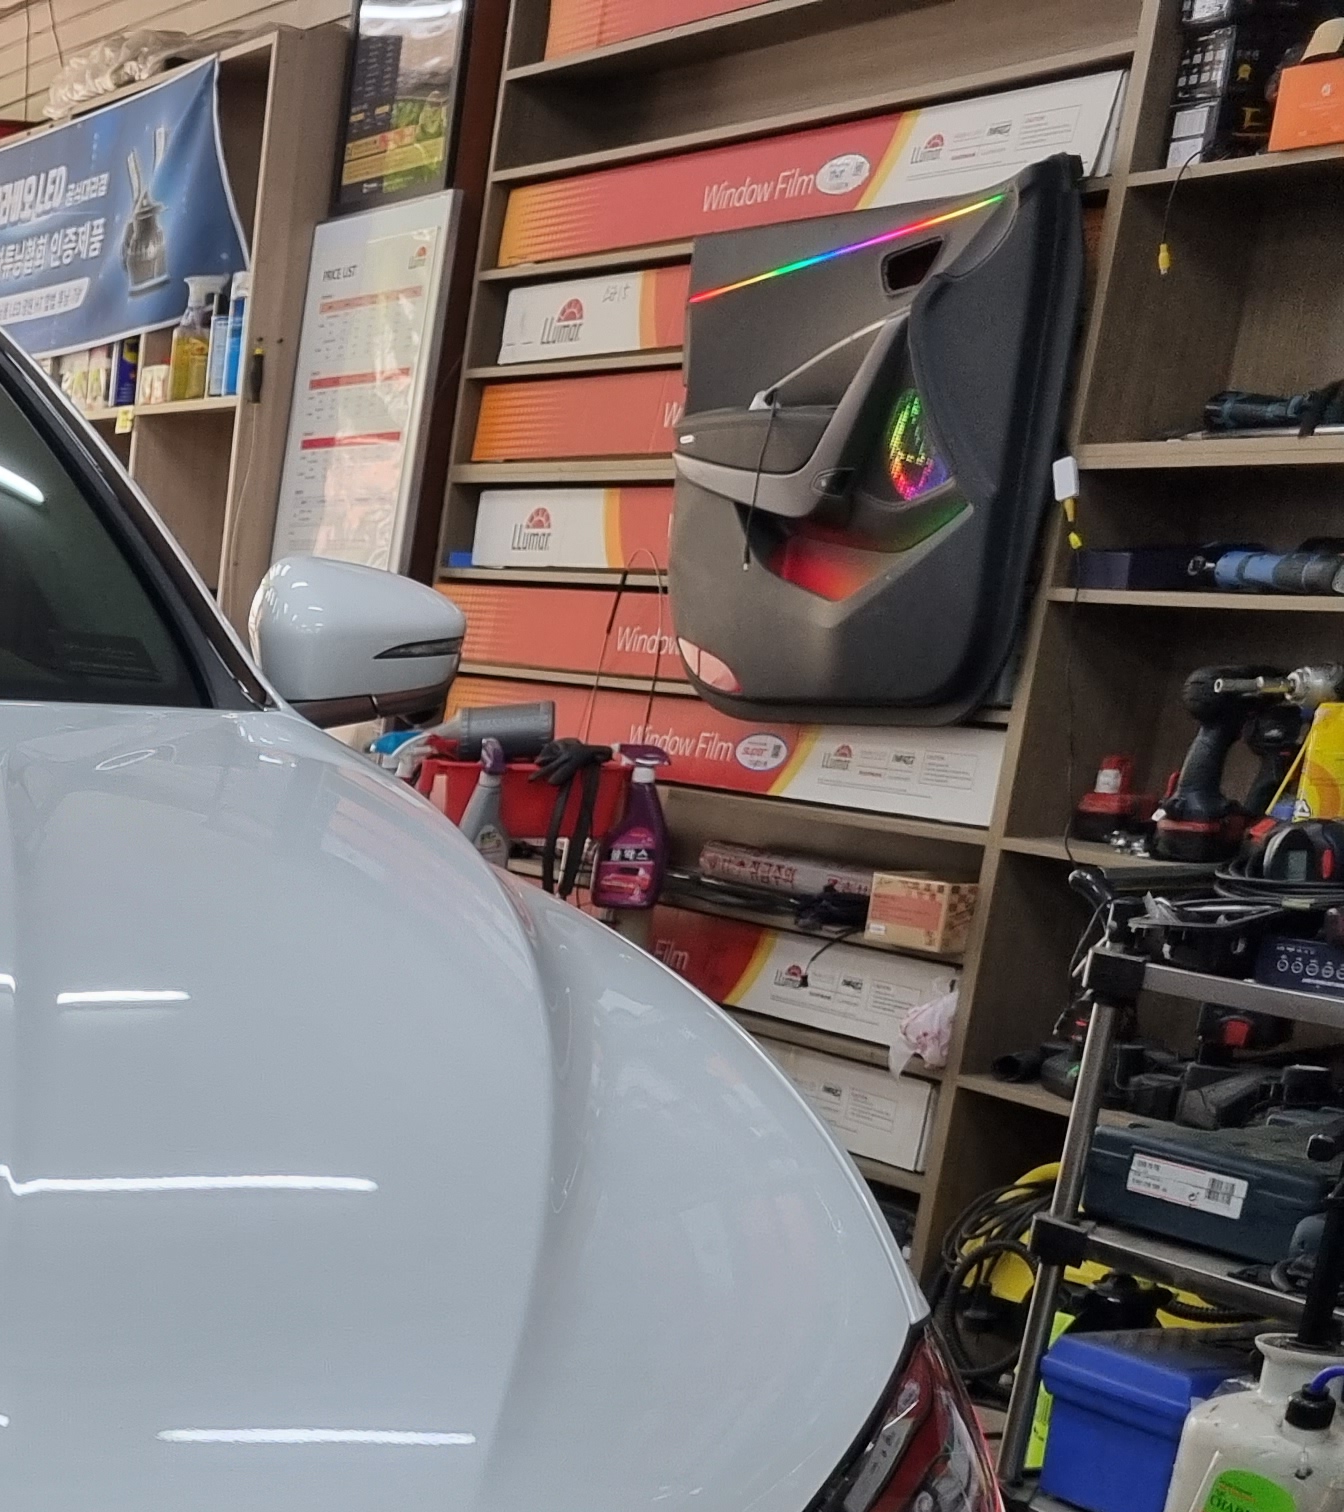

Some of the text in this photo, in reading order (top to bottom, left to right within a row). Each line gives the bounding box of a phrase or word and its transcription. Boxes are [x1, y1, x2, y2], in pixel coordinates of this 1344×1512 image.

[702, 175, 775, 212] Window
[775, 168, 815, 197] Film
[50, 217, 107, 269] 인증제품
[322, 265, 358, 282] PRICE LIST
[540, 316, 583, 345] LLumar
[511, 523, 551, 551] LLumar
[695, 732, 734, 762] Film
[655, 939, 690, 970] Film
